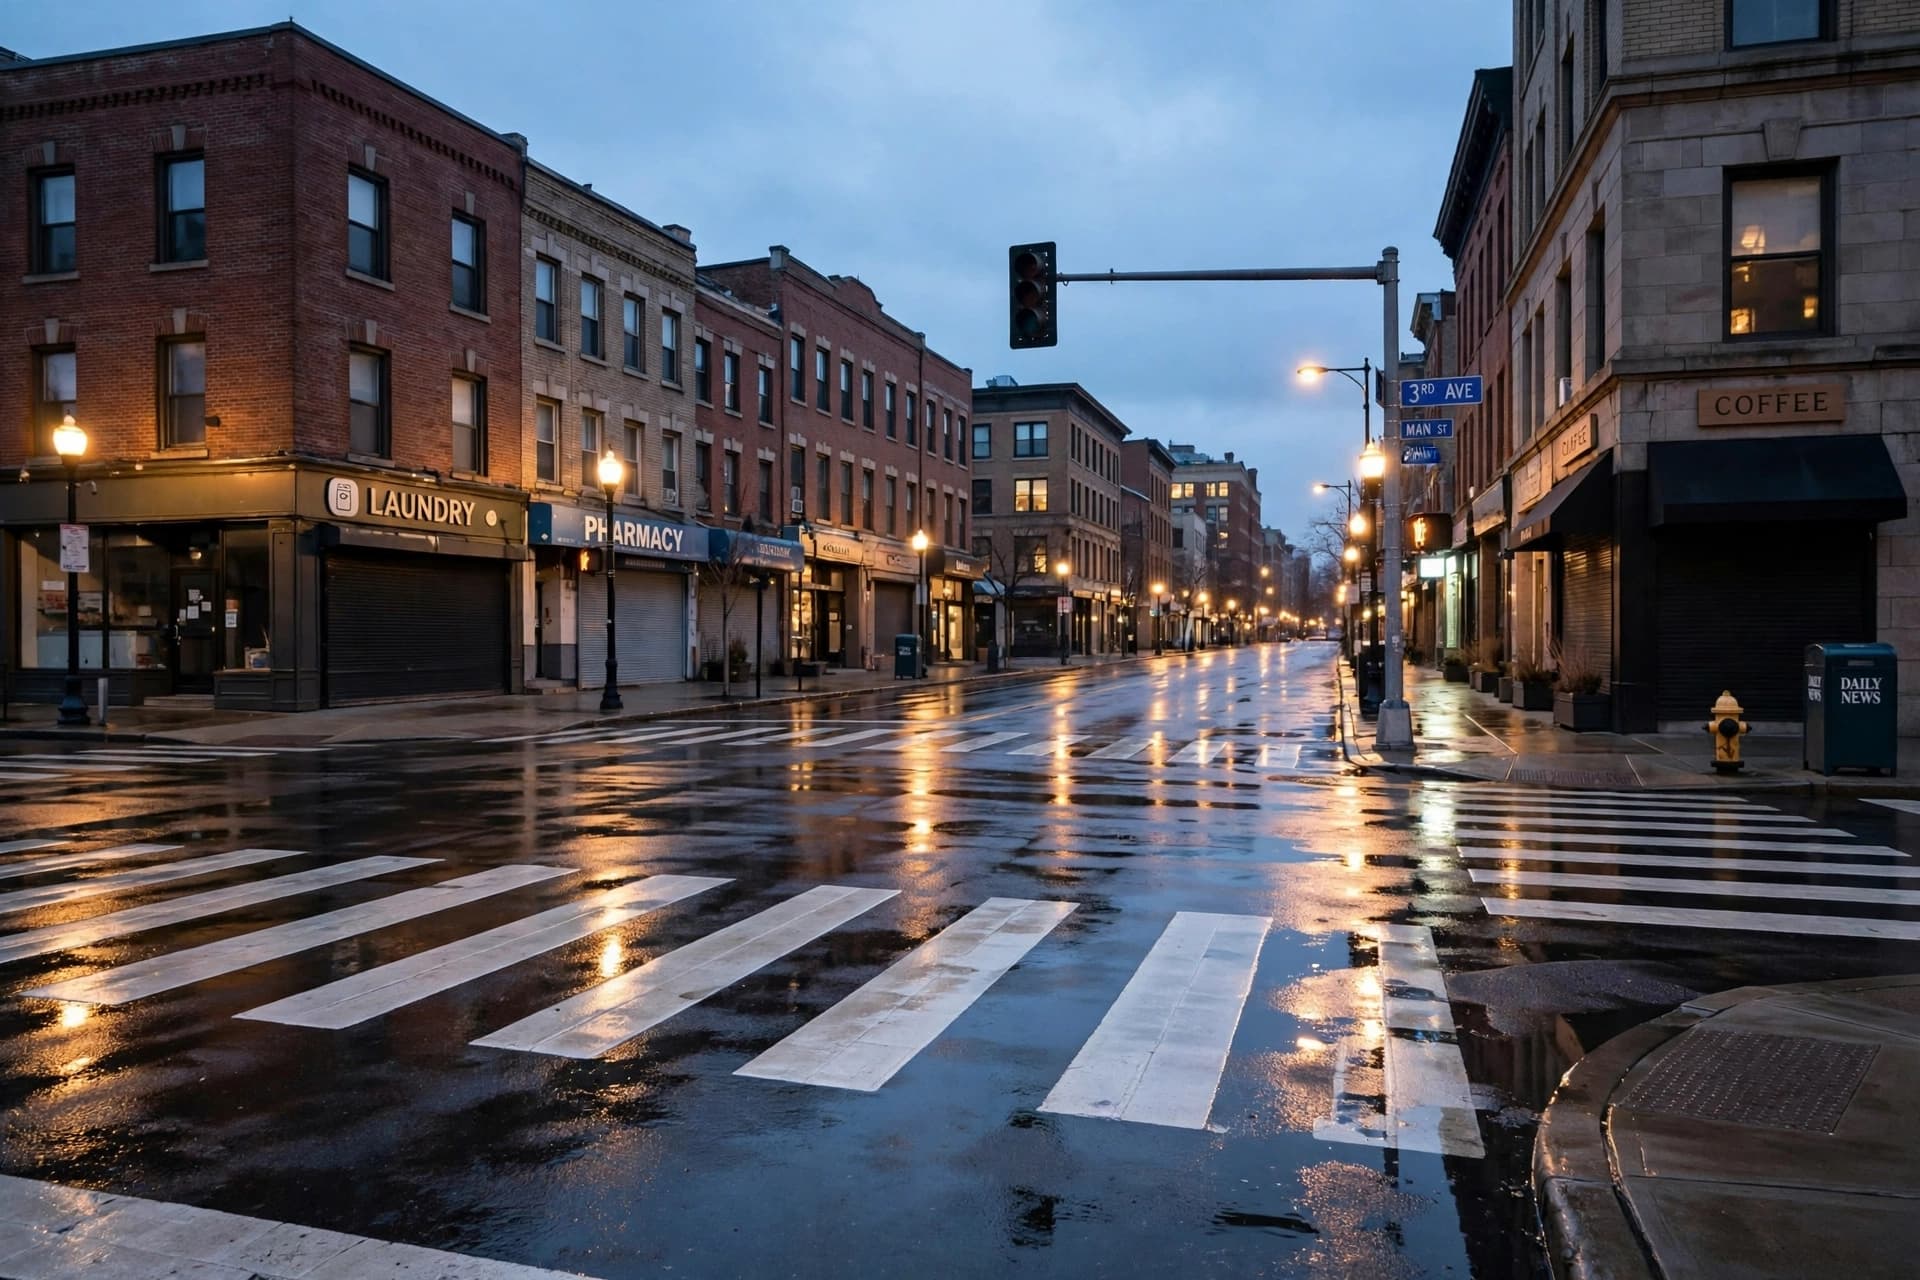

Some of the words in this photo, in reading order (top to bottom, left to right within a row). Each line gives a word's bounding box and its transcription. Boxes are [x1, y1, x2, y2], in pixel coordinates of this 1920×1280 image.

[1408, 383, 1435, 404] 3RD
[1445, 383, 1473, 400] AVE
[1714, 391, 1829, 416] COFFEE
[1406, 423, 1431, 436] MAN
[1437, 424, 1448, 435] ST
[369, 487, 476, 526] LAUNDRY
[584, 515, 684, 552] PHARMACY
[1840, 677, 1882, 690] DAILY
[1841, 691, 1881, 704] NEWS
